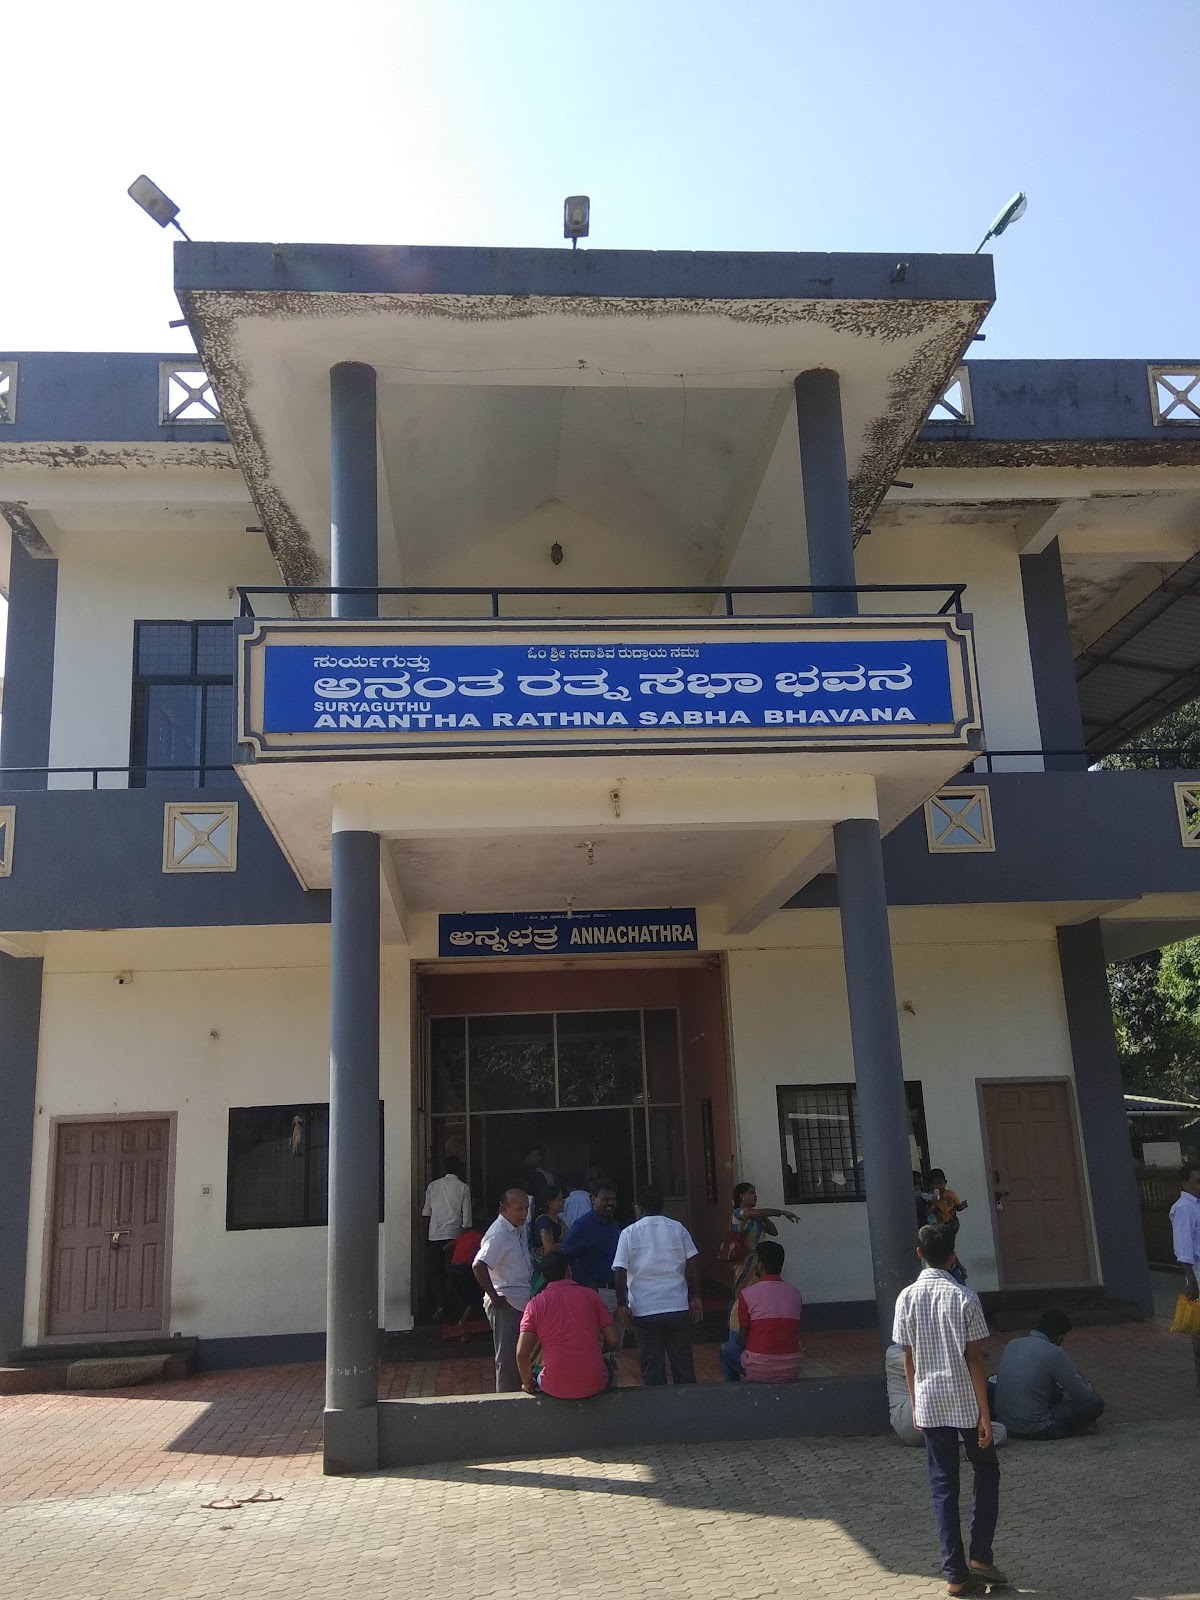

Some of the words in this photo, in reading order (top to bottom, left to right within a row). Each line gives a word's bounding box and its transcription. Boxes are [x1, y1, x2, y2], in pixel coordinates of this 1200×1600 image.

[527, 646, 547, 659] ಓಂ
[549, 647, 566, 662] ಶ್ರೀ
[569, 647, 615, 660] ಸದಾಶಿವ
[313, 667, 505, 699] ಅನಂತ
[517, 667, 632, 702] ರತ್ನ
[638, 666, 763, 699] ಸಭಾ
[775, 662, 913, 698] ಭವನ
[313, 701, 431, 712] SURYAGUTHU
[313, 712, 482, 728] ANANTHA
[492, 712, 629, 727] RATHNA
[638, 711, 752, 725] SABHA
[764, 707, 916, 724] BHAVANA
[569, 924, 695, 945] ANNACHATHRA
